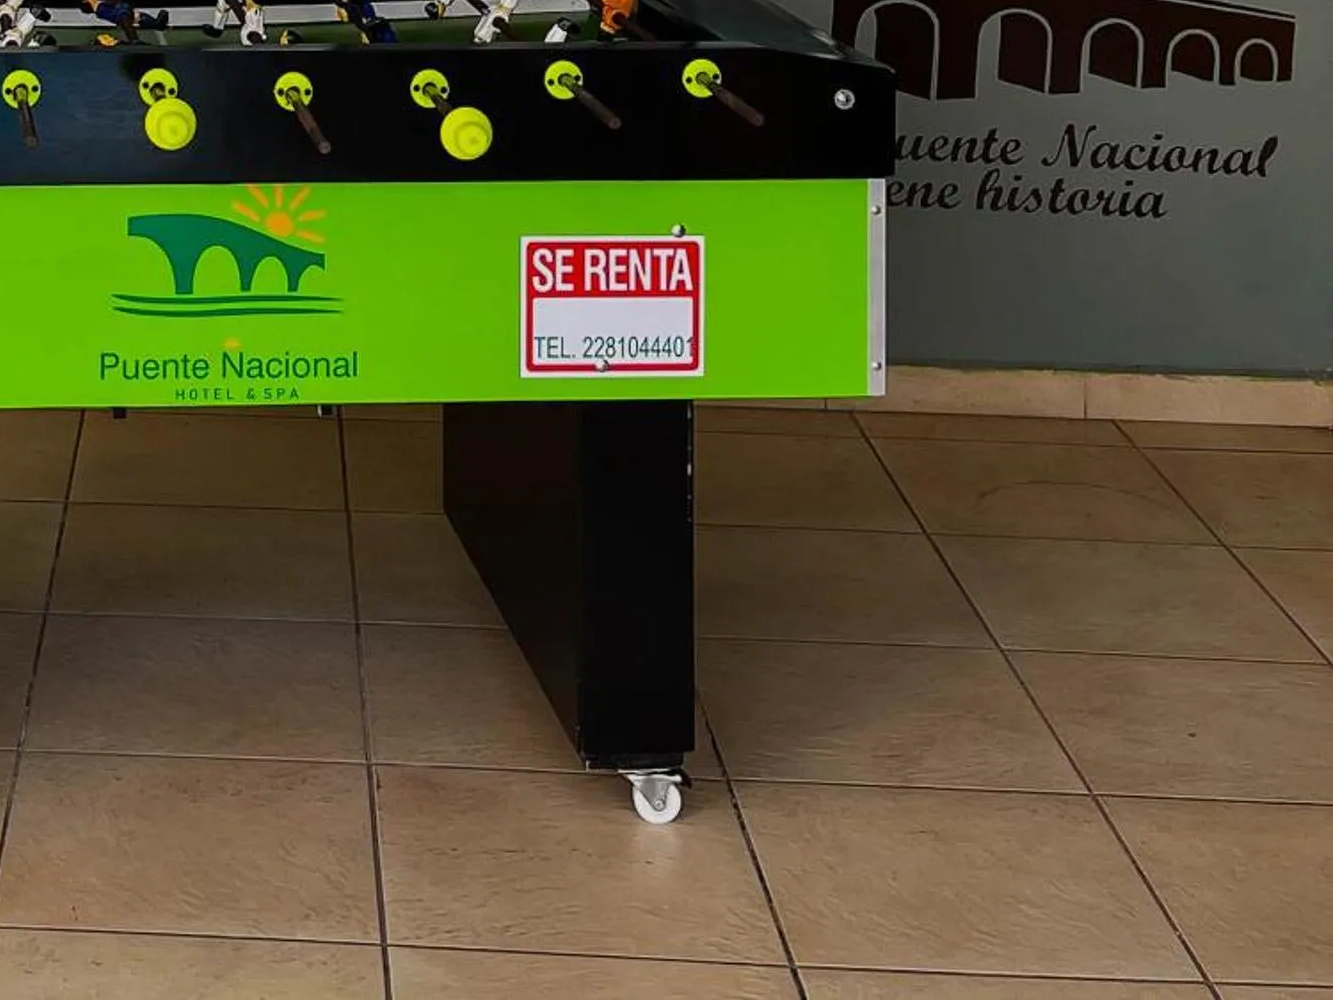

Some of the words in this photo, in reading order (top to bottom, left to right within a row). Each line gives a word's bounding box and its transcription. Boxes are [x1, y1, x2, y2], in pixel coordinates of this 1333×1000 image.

[894, 128, 1024, 165] uente
[1042, 123, 1278, 178] Nacional
[885, 177, 962, 210] ene
[975, 169, 1168, 219] historia
[532, 248, 575, 293] SE
[584, 248, 694, 292] RENTA
[100, 352, 209, 380] Puente
[222, 351, 358, 378] Nacional
[534, 336, 577, 359] TEL.
[583, 336, 694, 359] 2281044401
[176, 388, 234, 400] HOTEL
[246, 388, 256, 400] &
[264, 387, 300, 400] SPA
